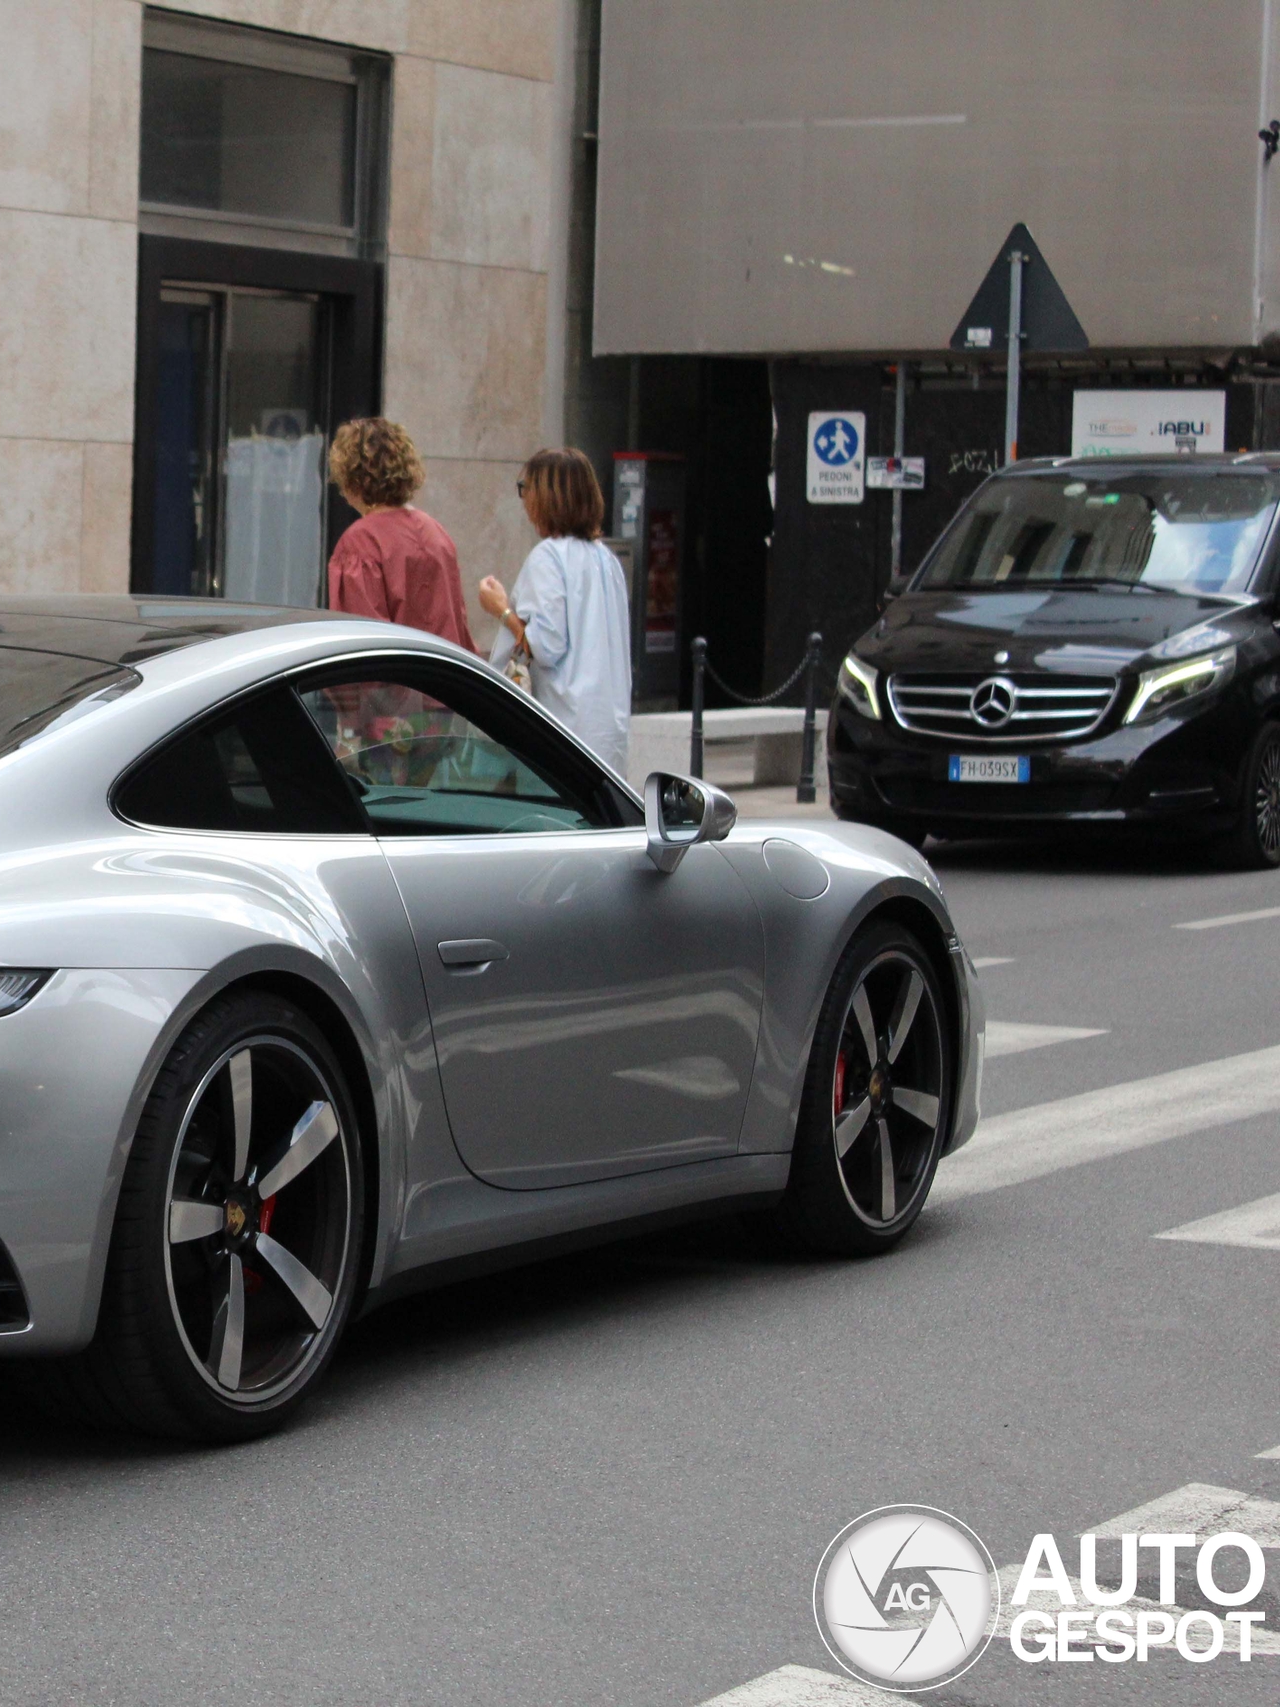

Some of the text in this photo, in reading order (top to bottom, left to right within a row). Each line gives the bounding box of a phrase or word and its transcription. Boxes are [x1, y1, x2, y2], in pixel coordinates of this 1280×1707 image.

[818, 471, 852, 481] PEDONI
[811, 486, 859, 497] A SINISTRA
